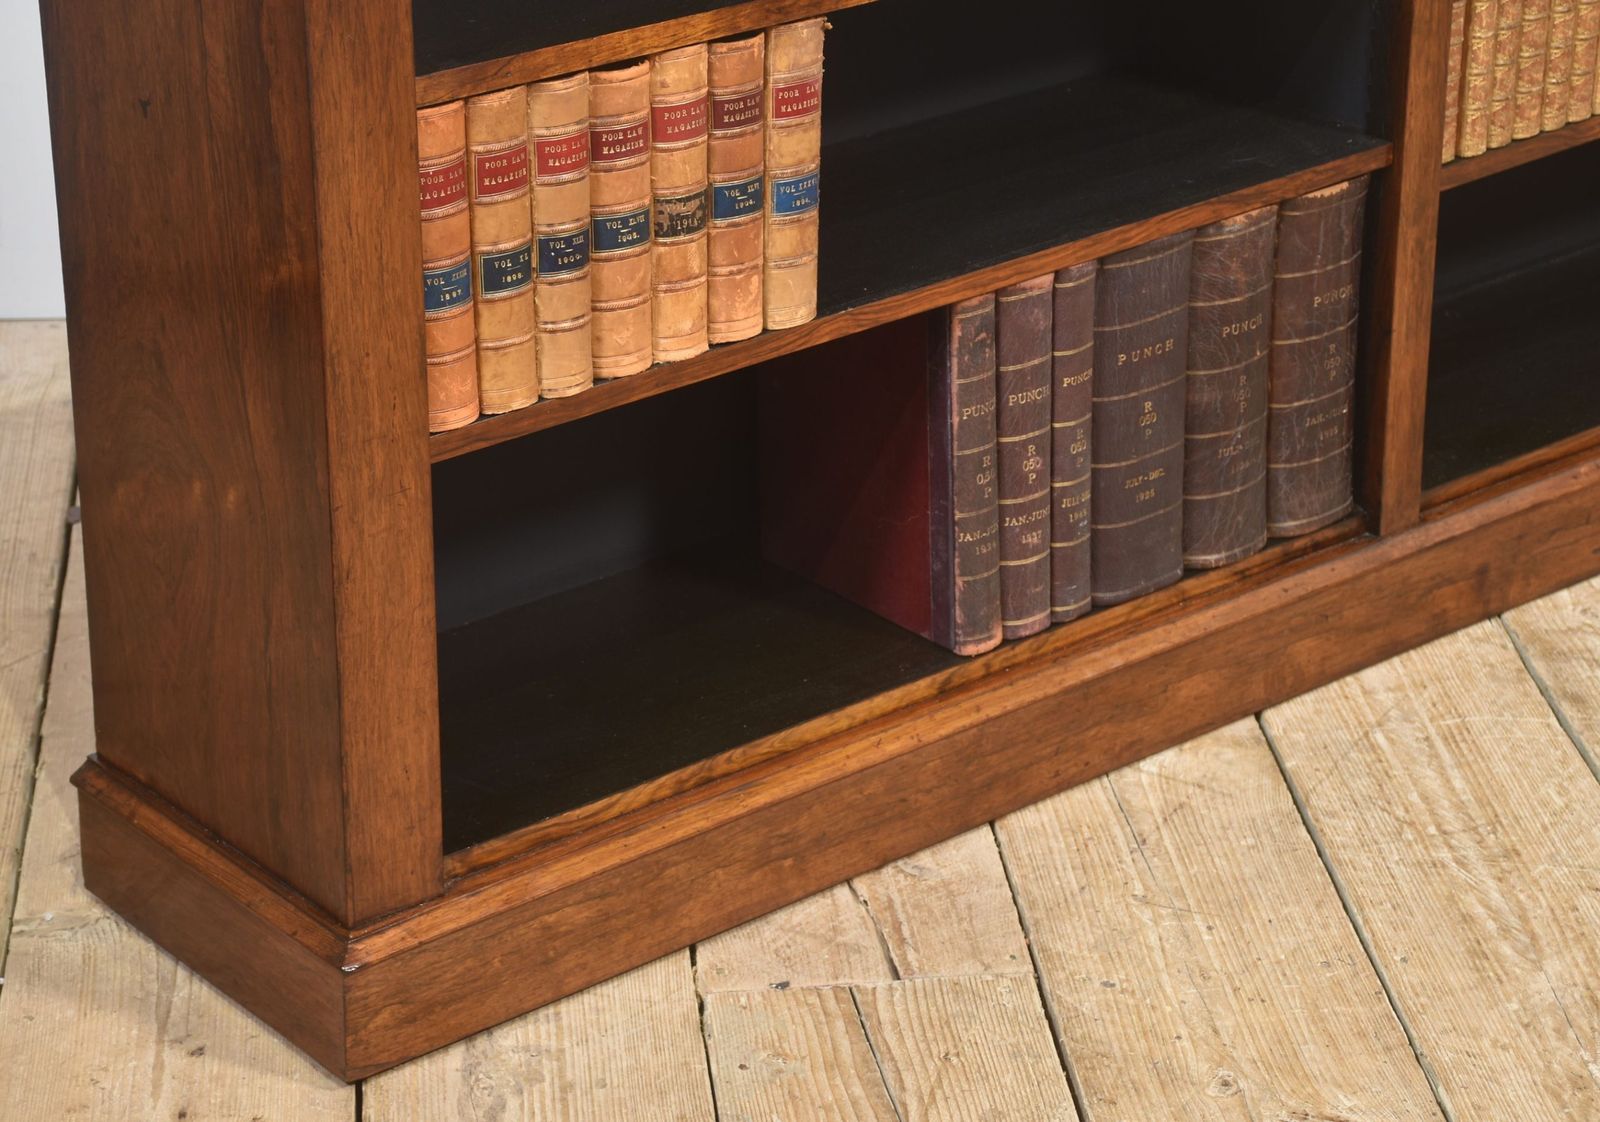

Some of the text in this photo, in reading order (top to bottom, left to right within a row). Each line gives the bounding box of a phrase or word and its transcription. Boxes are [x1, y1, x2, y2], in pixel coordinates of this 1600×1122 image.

[778, 82, 819, 100] POOR LAW
[664, 103, 705, 121] POOR LAW
[724, 96, 760, 112] POOR LAW
[780, 97, 819, 113] MAGAZINE
[723, 107, 760, 123] MAGAZINE
[666, 116, 706, 134] MAGAZINE
[601, 126, 644, 142] POOR LAW
[544, 137, 587, 154] POOR LAW
[602, 139, 645, 155] MAGAZINE
[485, 152, 526, 170] POOR LAW
[547, 150, 588, 167] MAGAZINE
[420, 167, 464, 186] POOR LAW
[483, 167, 528, 186] MAGAZINE
[724, 188, 741, 198] VOL
[779, 184, 797, 194] VOL
[605, 221, 623, 230] VOL
[549, 239, 566, 250] VOL
[494, 252, 529, 269] VOL XL
[426, 277, 445, 287] VOL
[1313, 284, 1353, 308] PUNCH
[1221, 313, 1263, 338] PUNCH
[1117, 338, 1175, 366] PUNCH
[1329, 343, 1336, 354] R
[1062, 367, 1093, 388] PUNCH
[1239, 375, 1248, 386] R
[1008, 383, 1050, 407] PUNCH
[962, 400, 996, 420] PUNC
[1144, 401, 1153, 413] R
[1239, 402, 1248, 413] P
[1139, 412, 1157, 427] 050
[1145, 428, 1152, 440] P
[1028, 444, 1037, 457] R
[1070, 440, 1087, 455] 050
[982, 455, 992, 467] R
[1022, 456, 1042, 472] 050
[1076, 457, 1084, 468] P
[1028, 473, 1037, 485] P
[984, 486, 993, 498] P
